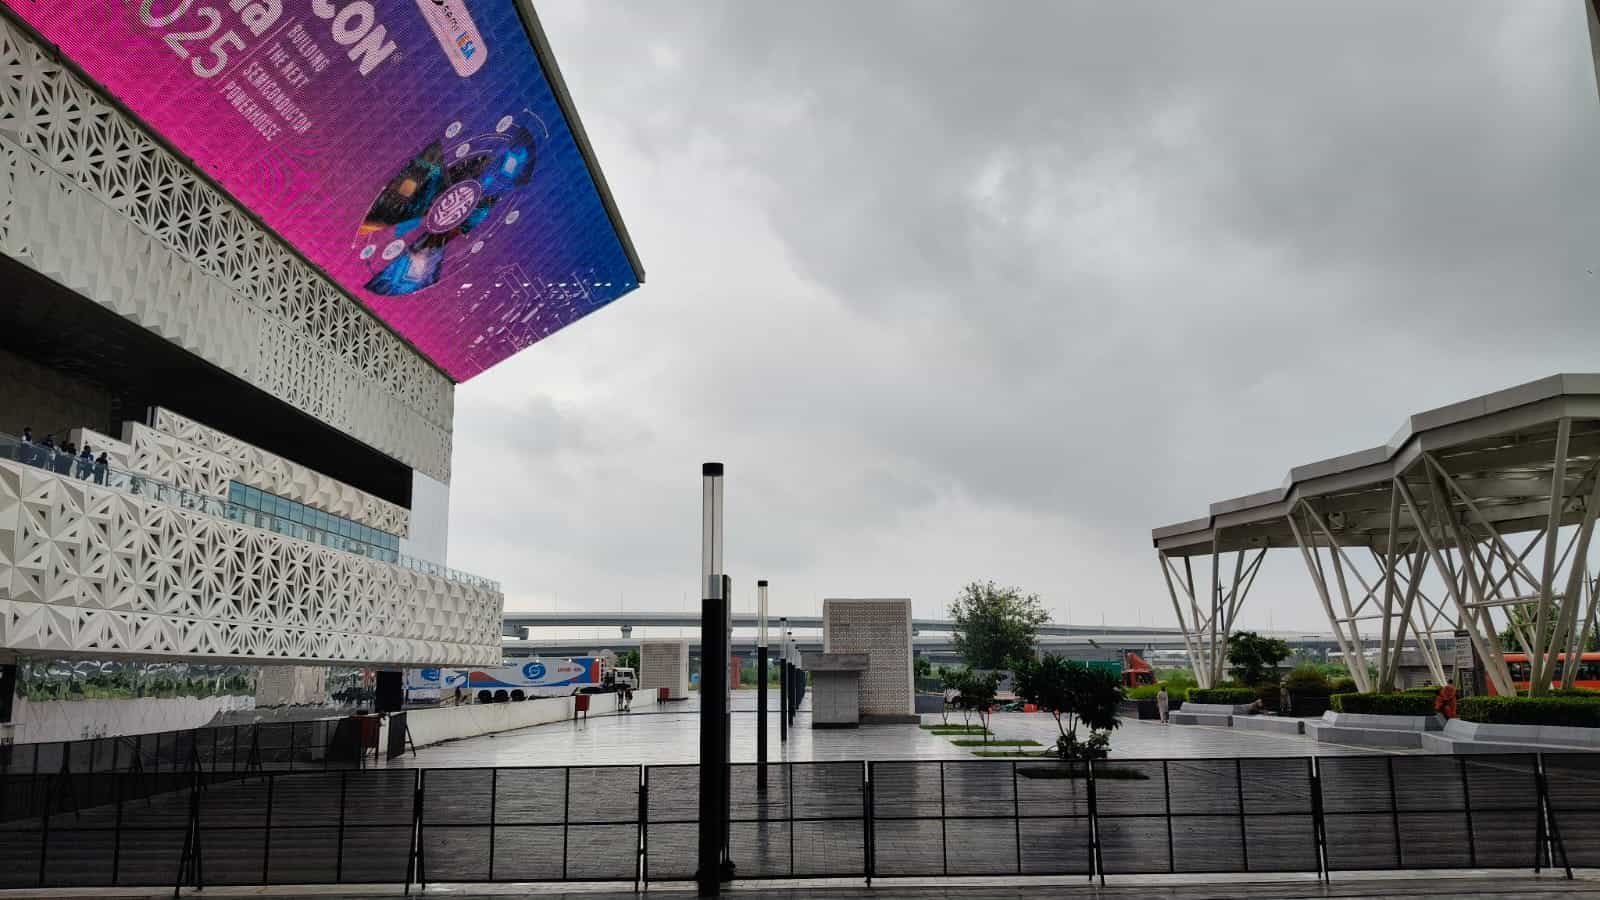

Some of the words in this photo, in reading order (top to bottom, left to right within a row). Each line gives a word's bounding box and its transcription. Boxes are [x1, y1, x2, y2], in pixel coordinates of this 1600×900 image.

[265, 42, 289, 68] THE
[281, 61, 309, 88] NEXT
[287, 24, 329, 72] BUILDING
[219, 80, 281, 141] POWERHOUSE
[243, 62, 312, 134] SEMICONDUCTOR
